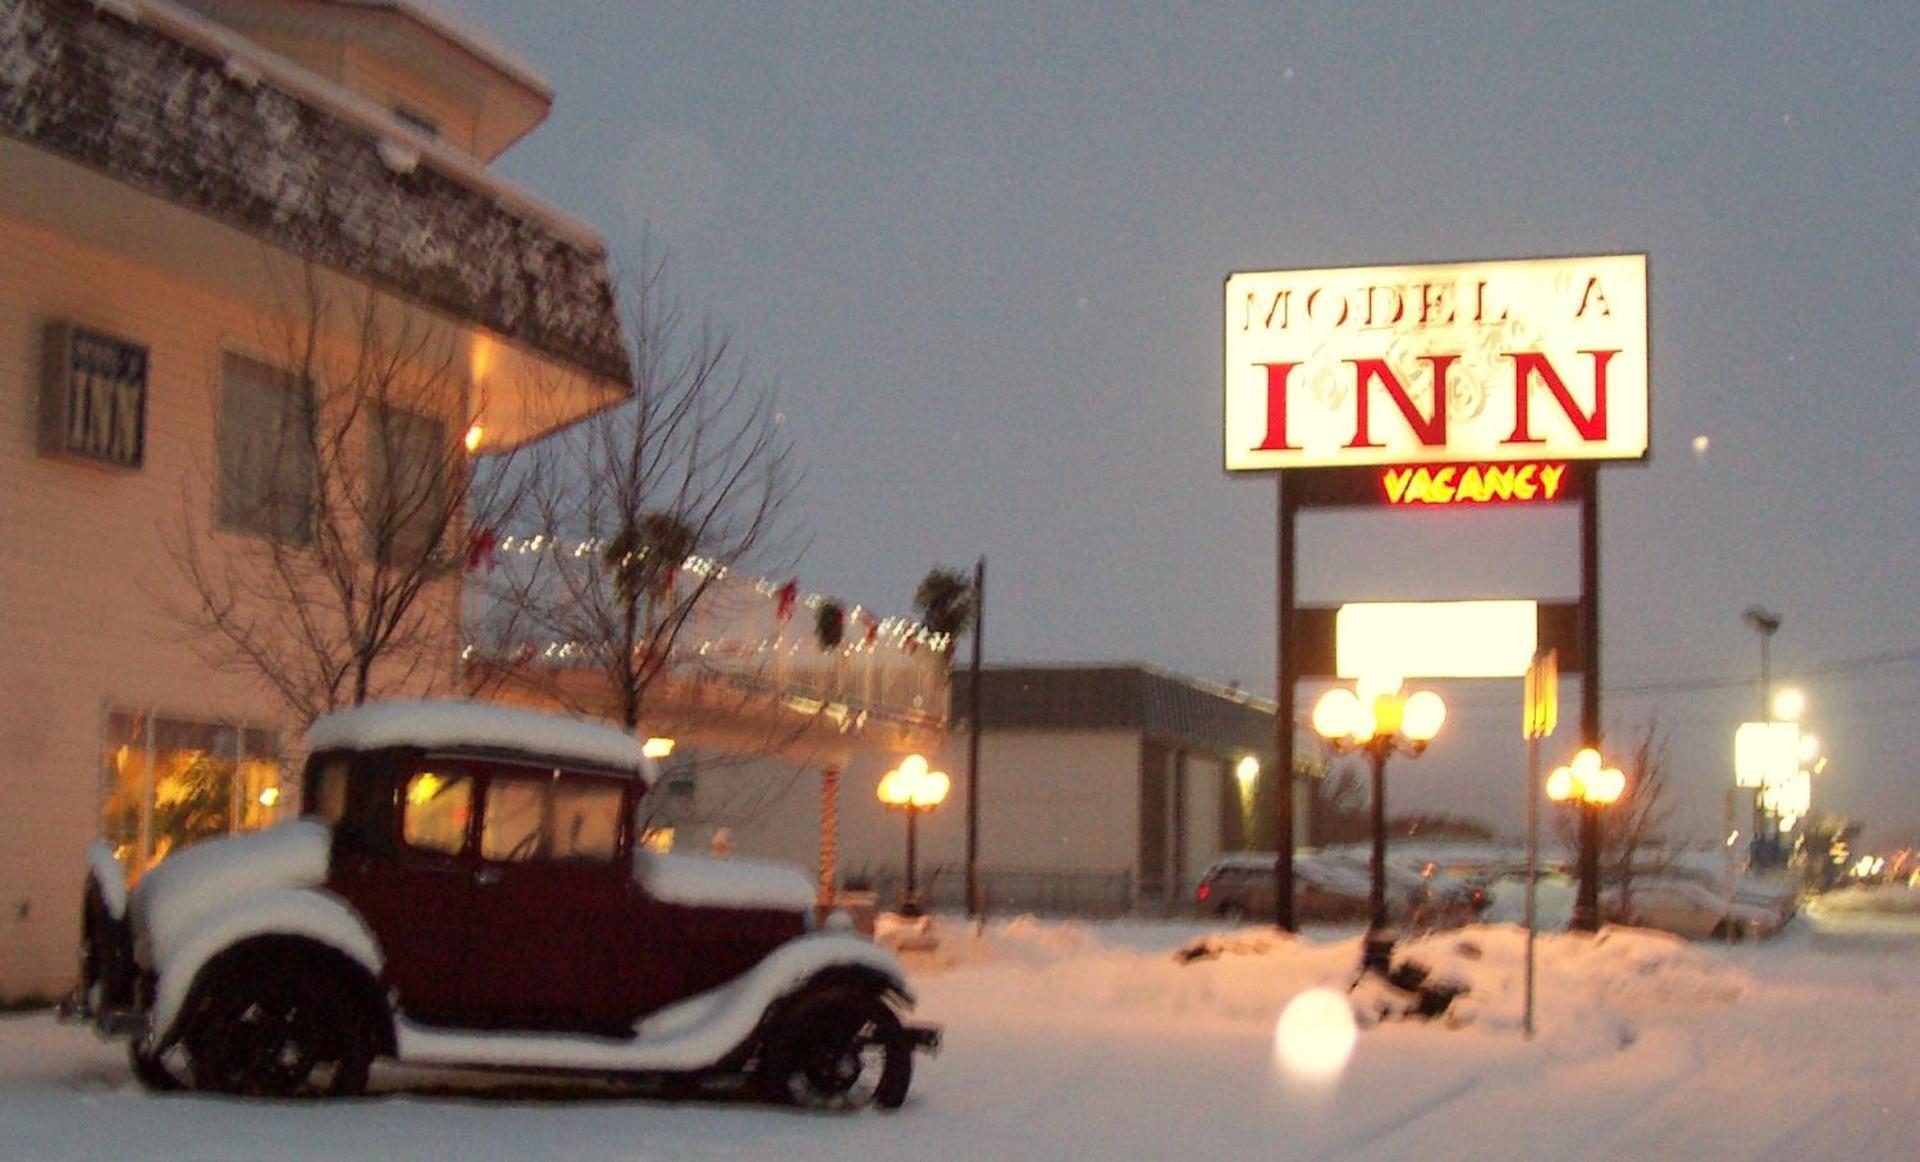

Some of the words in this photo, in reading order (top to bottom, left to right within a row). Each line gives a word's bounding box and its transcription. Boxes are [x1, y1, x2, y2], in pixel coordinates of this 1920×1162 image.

[1244, 281, 1508, 331] MODEL
[1250, 349, 1623, 452] INN
[1383, 464, 1566, 504] VACANCY
